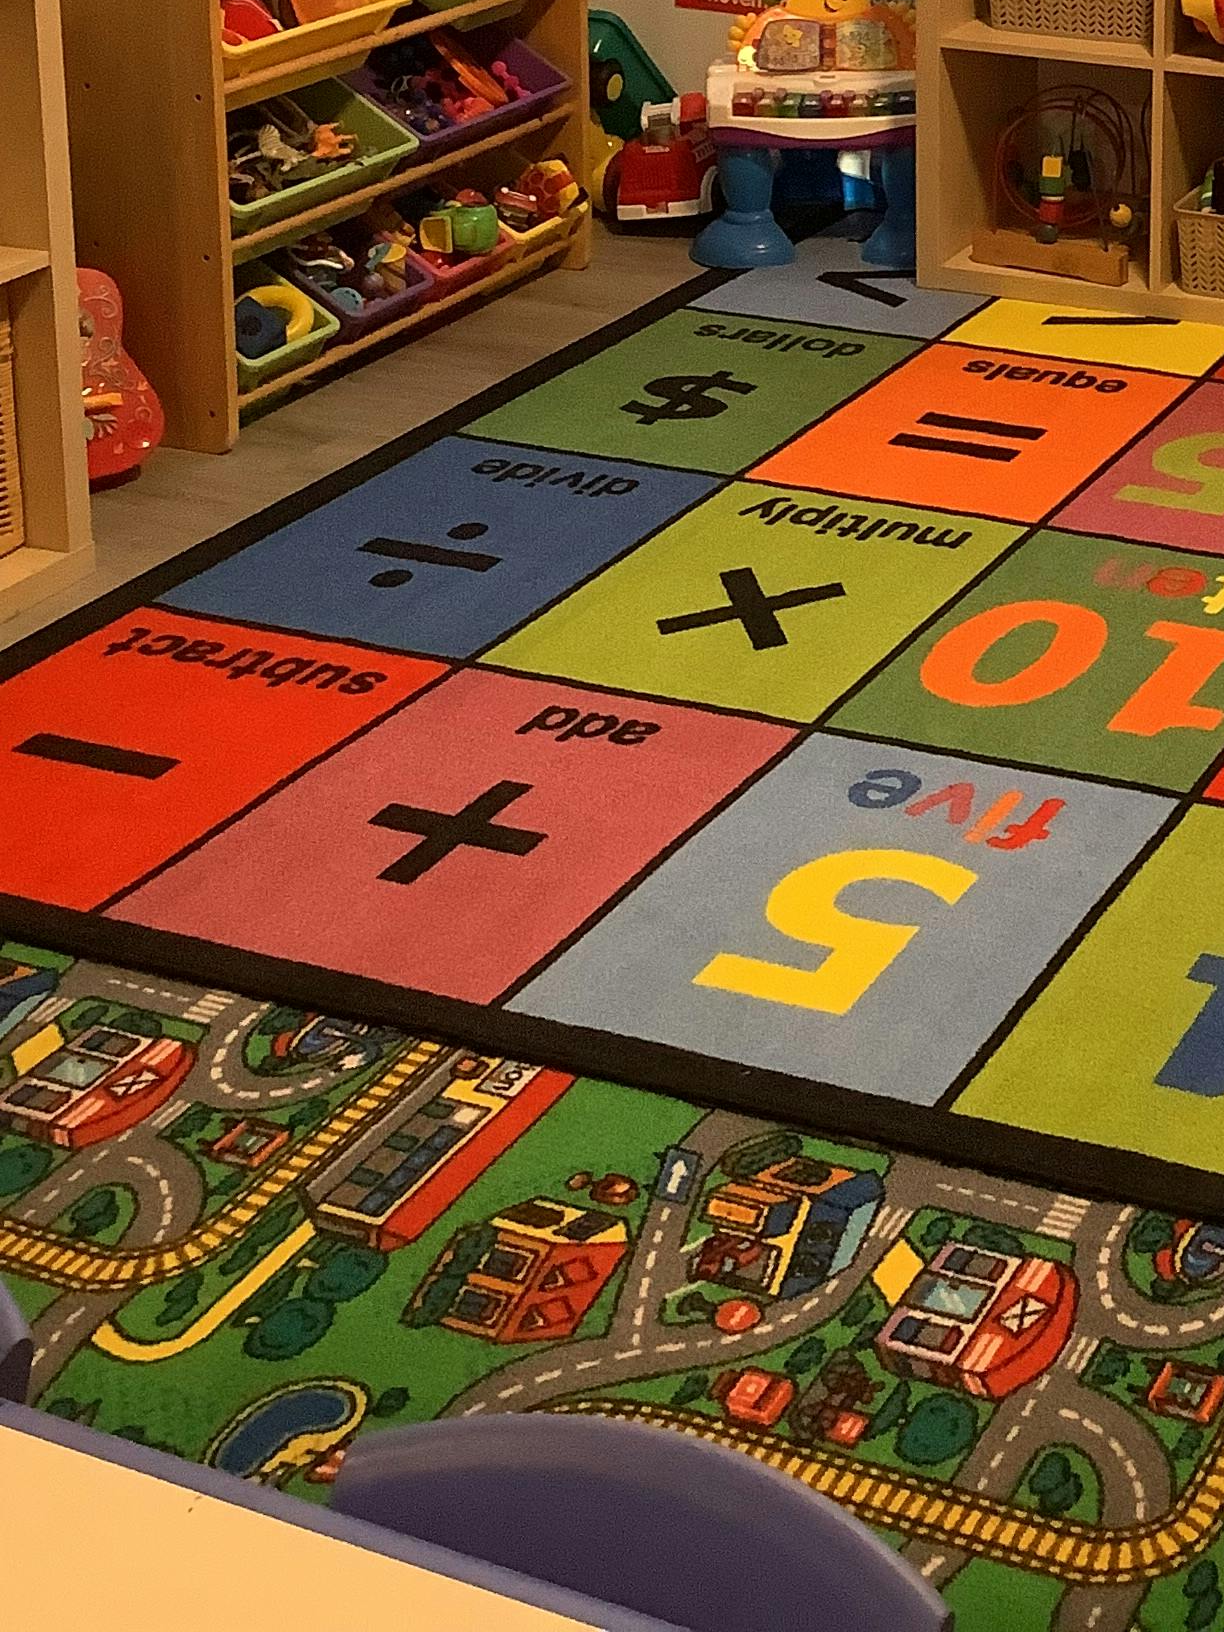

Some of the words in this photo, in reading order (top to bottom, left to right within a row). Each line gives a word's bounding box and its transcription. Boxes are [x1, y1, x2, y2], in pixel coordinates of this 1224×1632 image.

[694, 323, 865, 359] dollars
[619, 370, 758, 426] $
[962, 358, 1128, 396] equals
[472, 457, 641, 498] divide
[737, 496, 973, 551] multiply
[103, 627, 390, 696] subtract
[515, 704, 662, 747] add
[847, 767, 1067, 851] five
[691, 848, 980, 1017] 5
